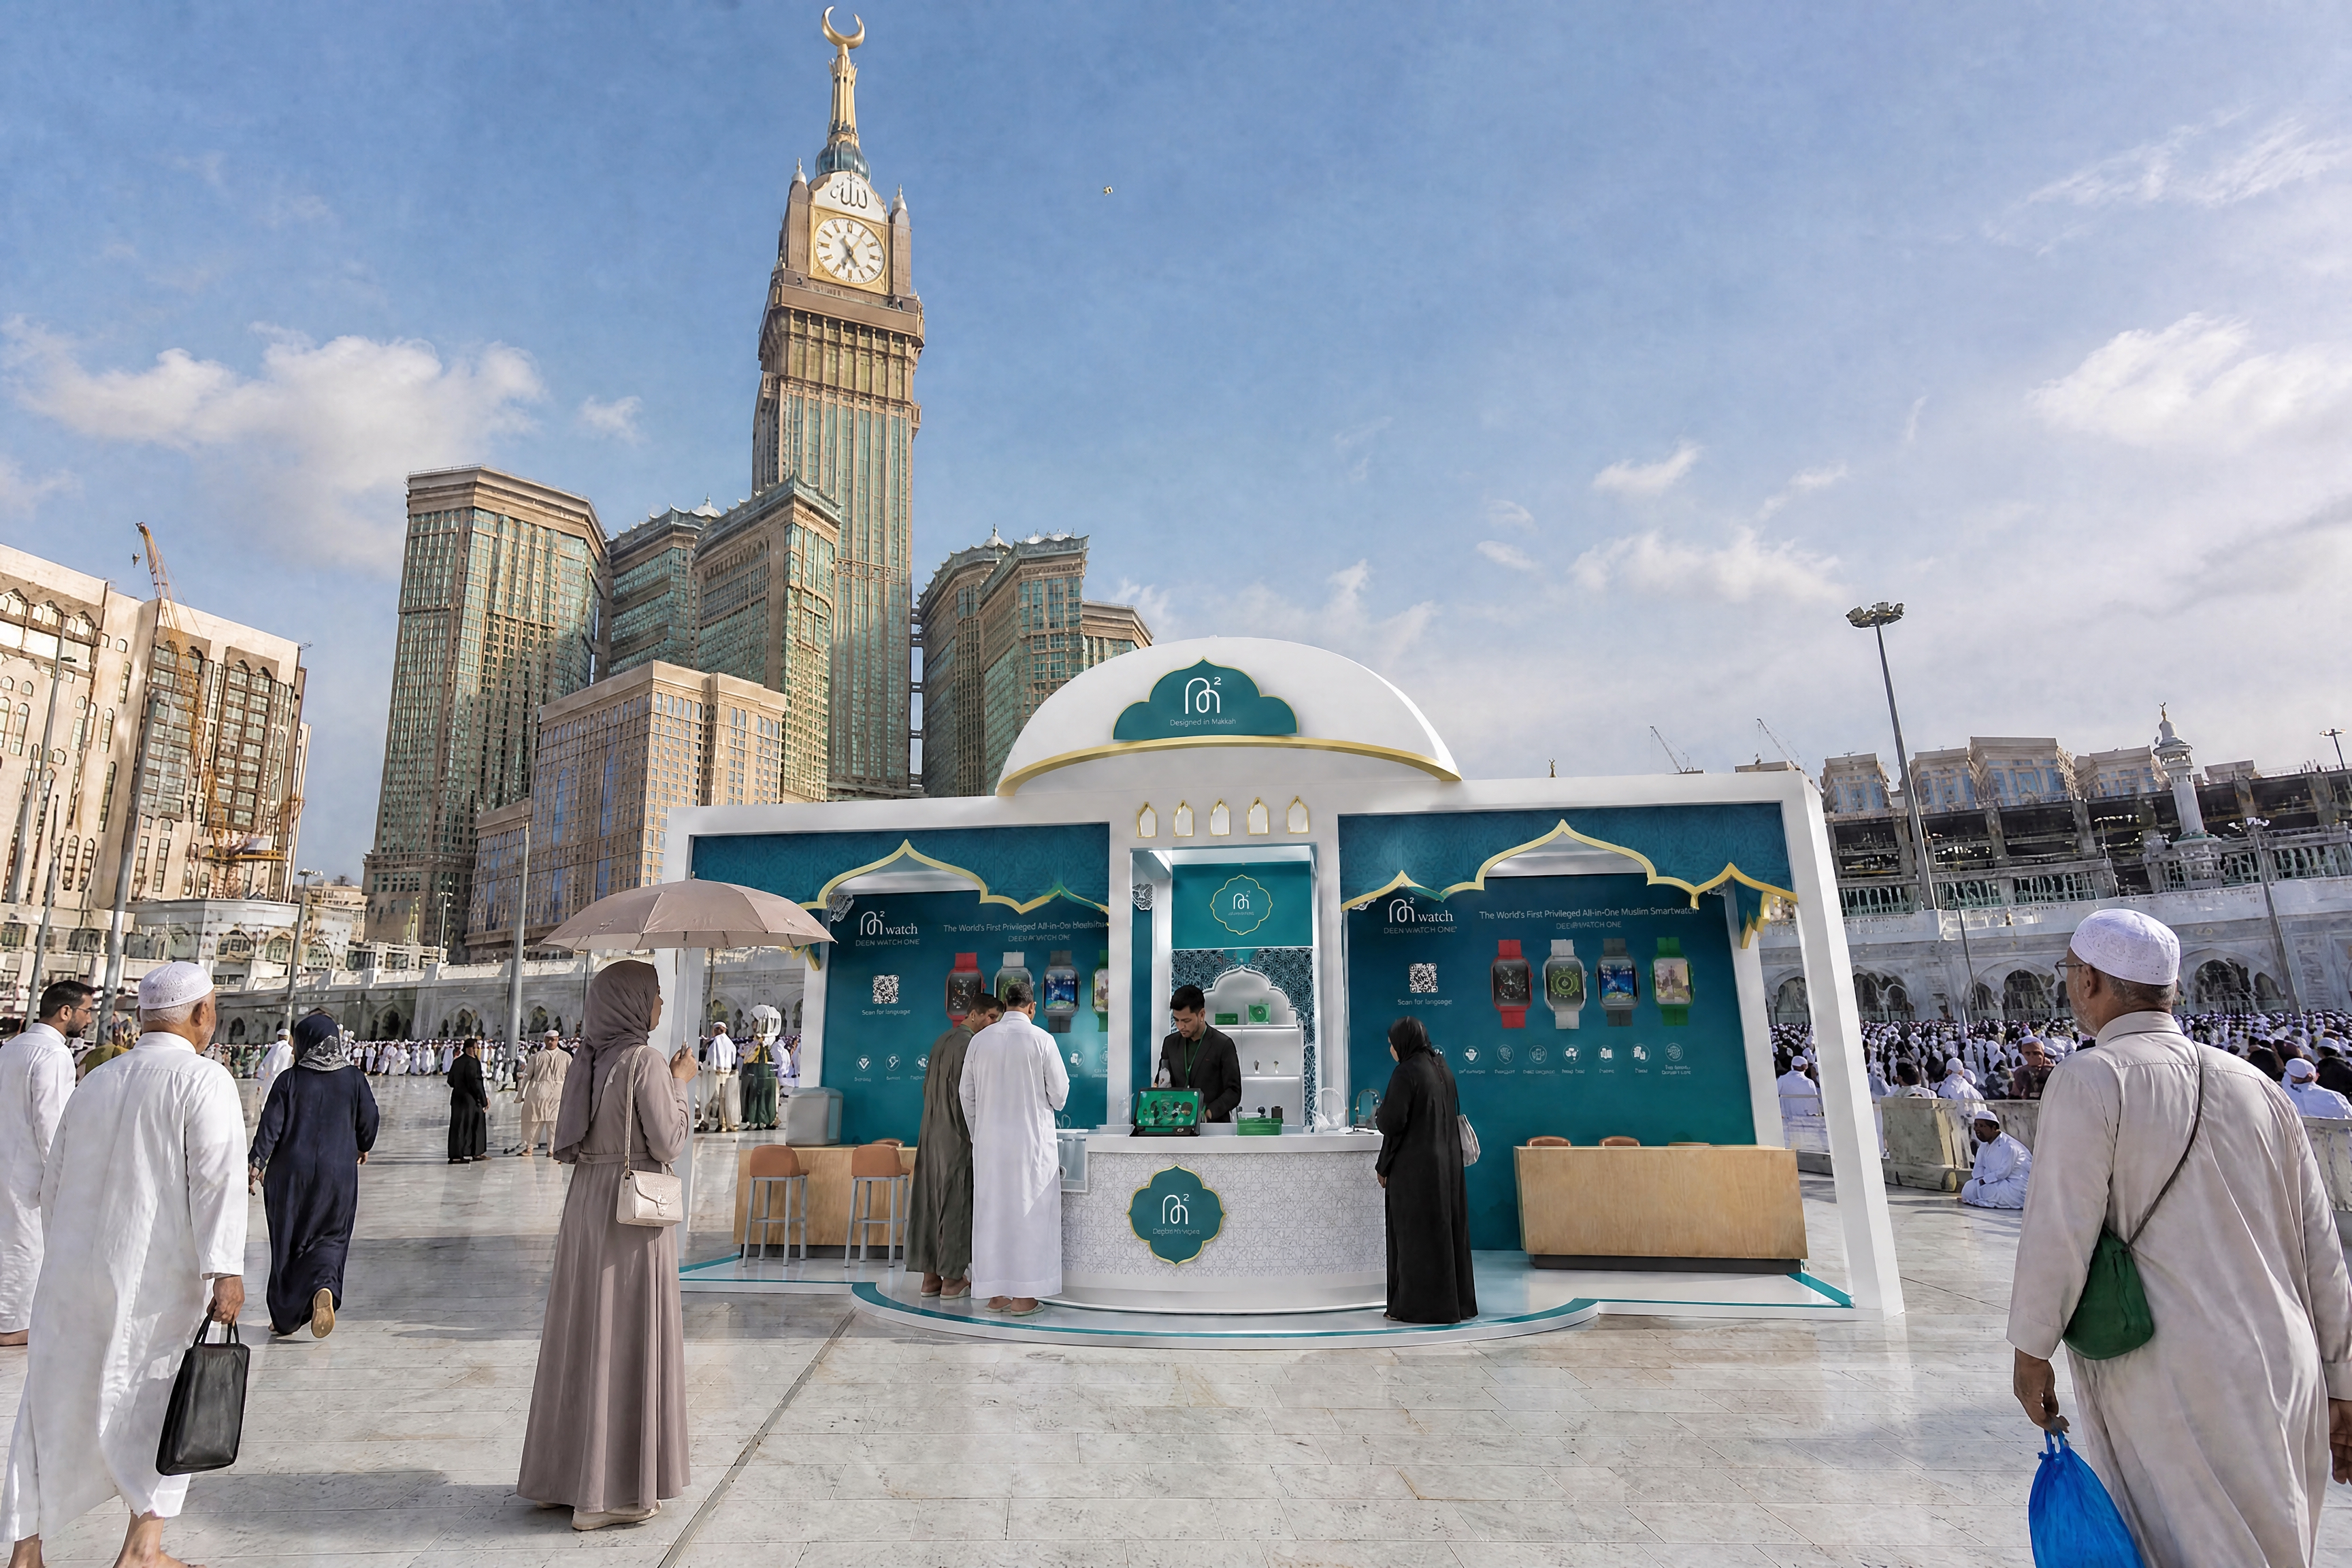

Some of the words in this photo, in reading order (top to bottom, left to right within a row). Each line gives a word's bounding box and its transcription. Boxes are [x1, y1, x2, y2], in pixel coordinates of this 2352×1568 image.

[1170, 719, 1201, 728] Designed
[1418, 911, 1454, 922] watch
[1479, 911, 1494, 919] The
[1497, 910, 1525, 919] World's
[1526, 910, 1542, 918] First
[1544, 909, 1581, 919] Privileged
[1582, 908, 1619, 917] All-in-One
[1621, 907, 1648, 916] Muslim
[1650, 906, 1697, 915] Smartwatch
[885, 923, 918, 934] watch
[958, 924, 985, 932] World's
[1002, 922, 1036, 932] Privileged
